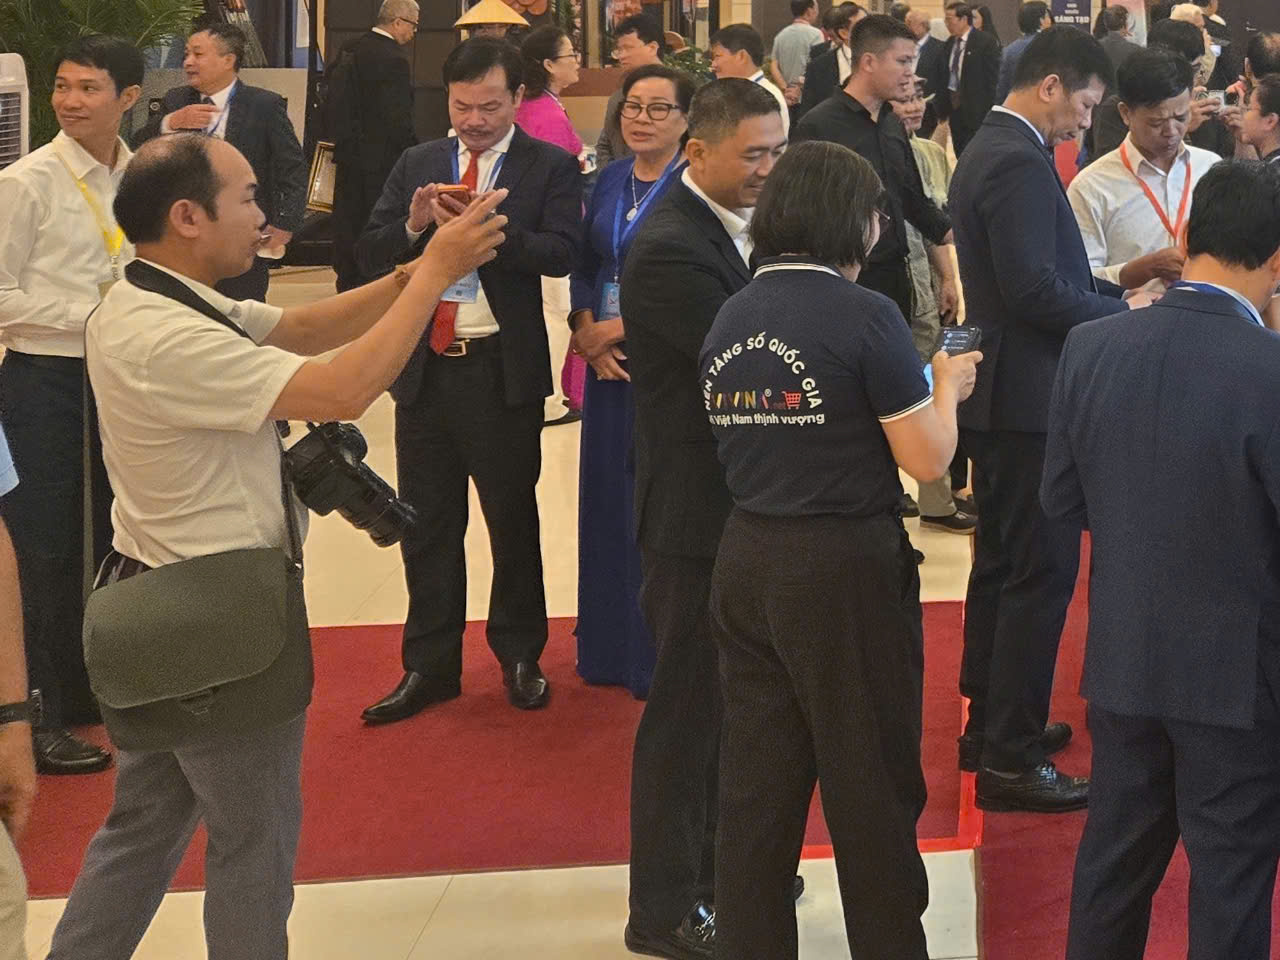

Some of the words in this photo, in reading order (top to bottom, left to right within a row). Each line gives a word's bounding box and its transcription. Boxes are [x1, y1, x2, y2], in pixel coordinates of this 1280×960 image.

[746, 331, 766, 350] SỐ
[769, 338, 805, 374] QUỐC
[802, 377, 823, 409] GIA
[714, 413, 731, 427] Việt
[732, 414, 752, 425] Nam
[753, 413, 779, 427] thịnh
[781, 413, 825, 427] vượng
